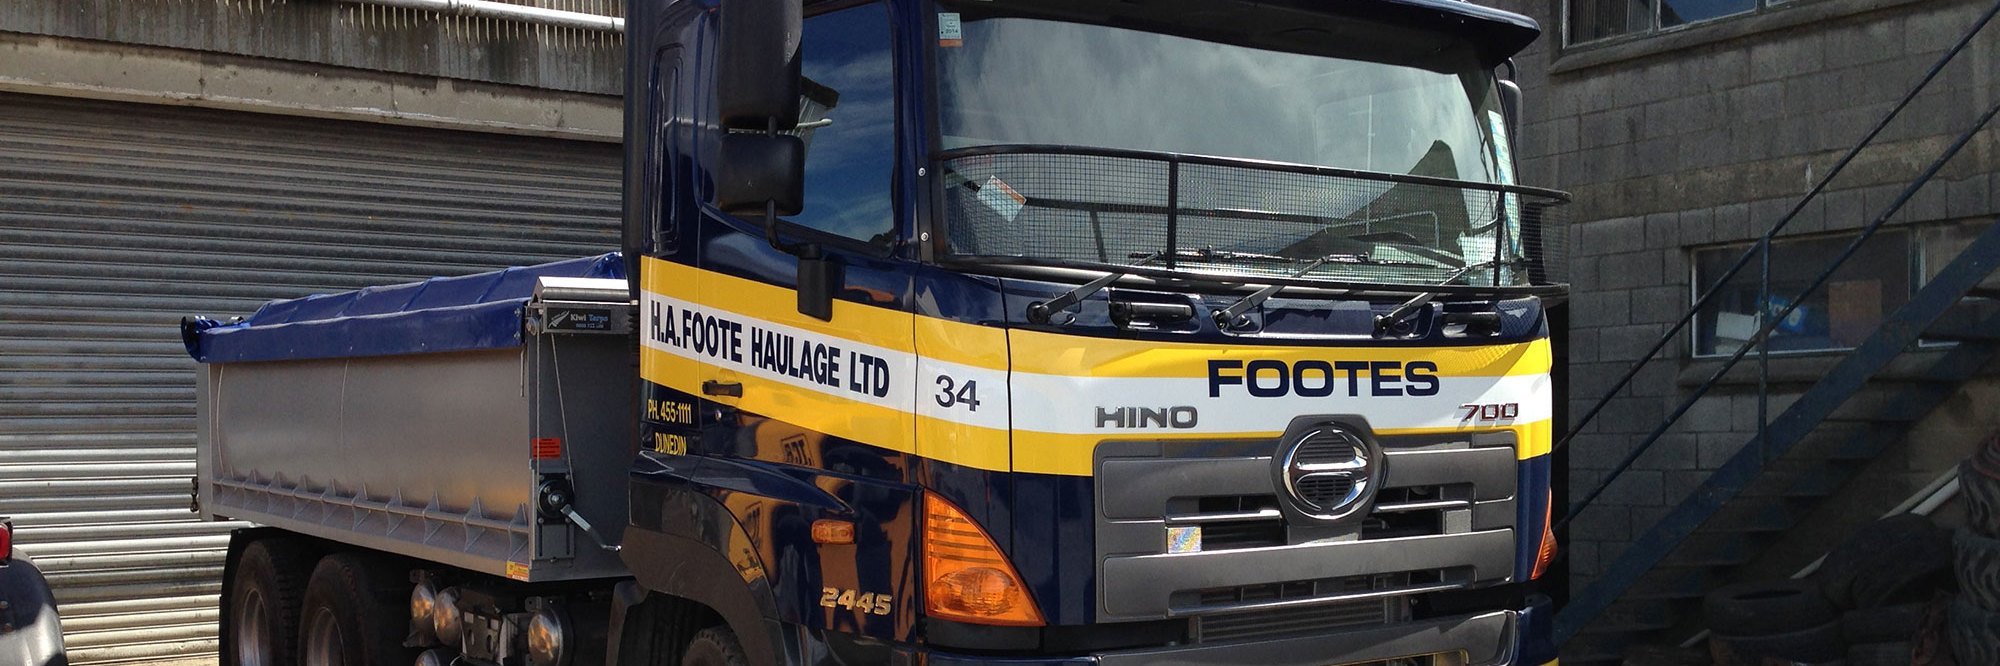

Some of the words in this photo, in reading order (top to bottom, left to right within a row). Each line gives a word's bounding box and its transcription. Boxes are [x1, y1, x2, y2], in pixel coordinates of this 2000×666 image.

[751, 326, 840, 388] HAULAGE
[849, 351, 890, 399] LTD
[1208, 359, 1440, 398] FOOTES
[934, 373, 981, 413] 34
[648, 399, 660, 420] PH.
[660, 400, 692, 425] 455-1111
[1094, 405, 1199, 430] HINO
[1458, 402, 1519, 422] 700
[655, 432, 687, 457] DUNEDIN
[819, 586, 893, 616] 2445
